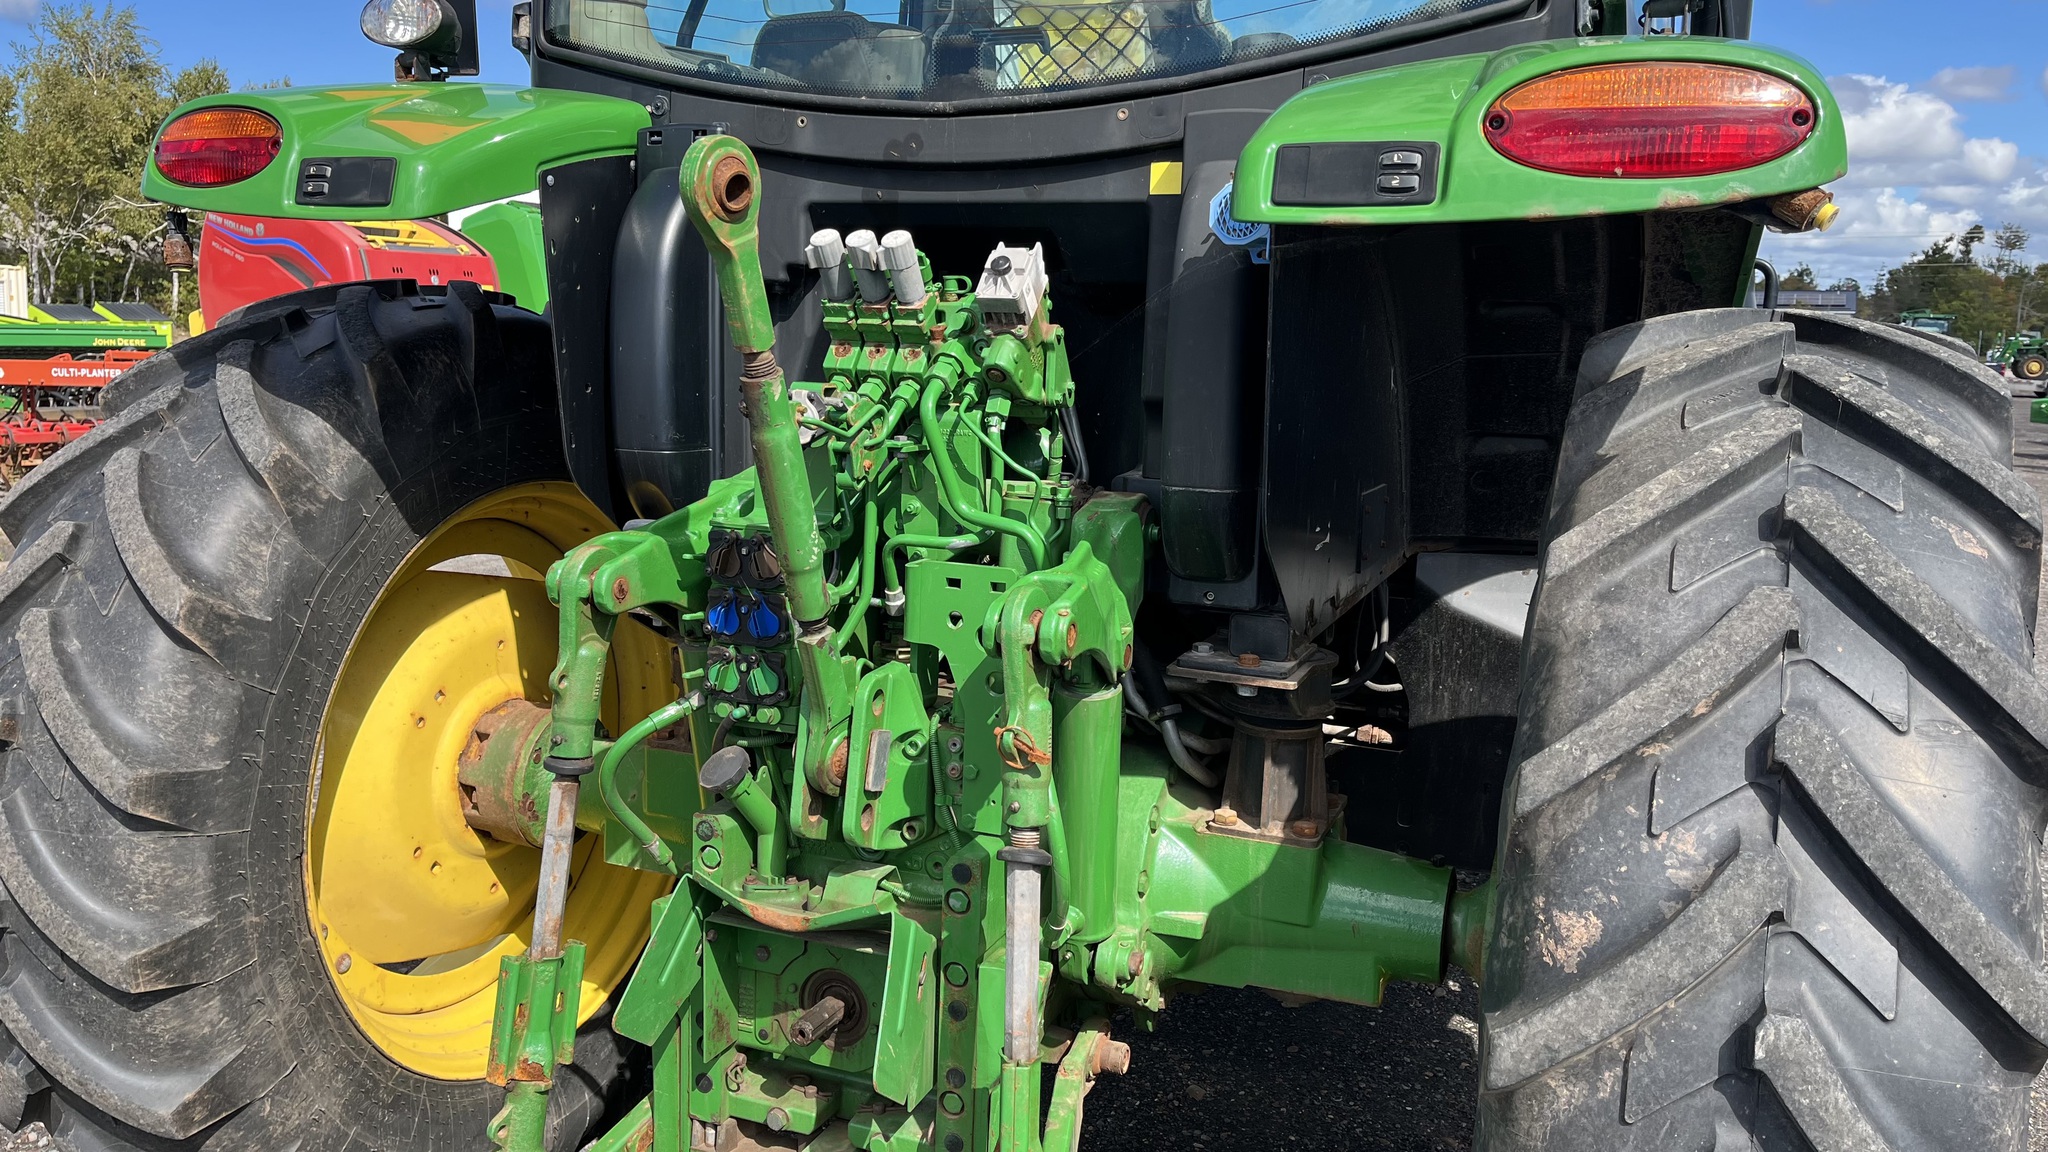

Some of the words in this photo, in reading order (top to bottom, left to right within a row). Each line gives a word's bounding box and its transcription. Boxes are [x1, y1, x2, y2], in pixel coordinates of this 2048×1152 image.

[208, 213, 223, 224] NEW
[223, 218, 254, 236] HOLLAND
[92, 338, 116, 346] JOHN
[117, 338, 146, 346] DEERE
